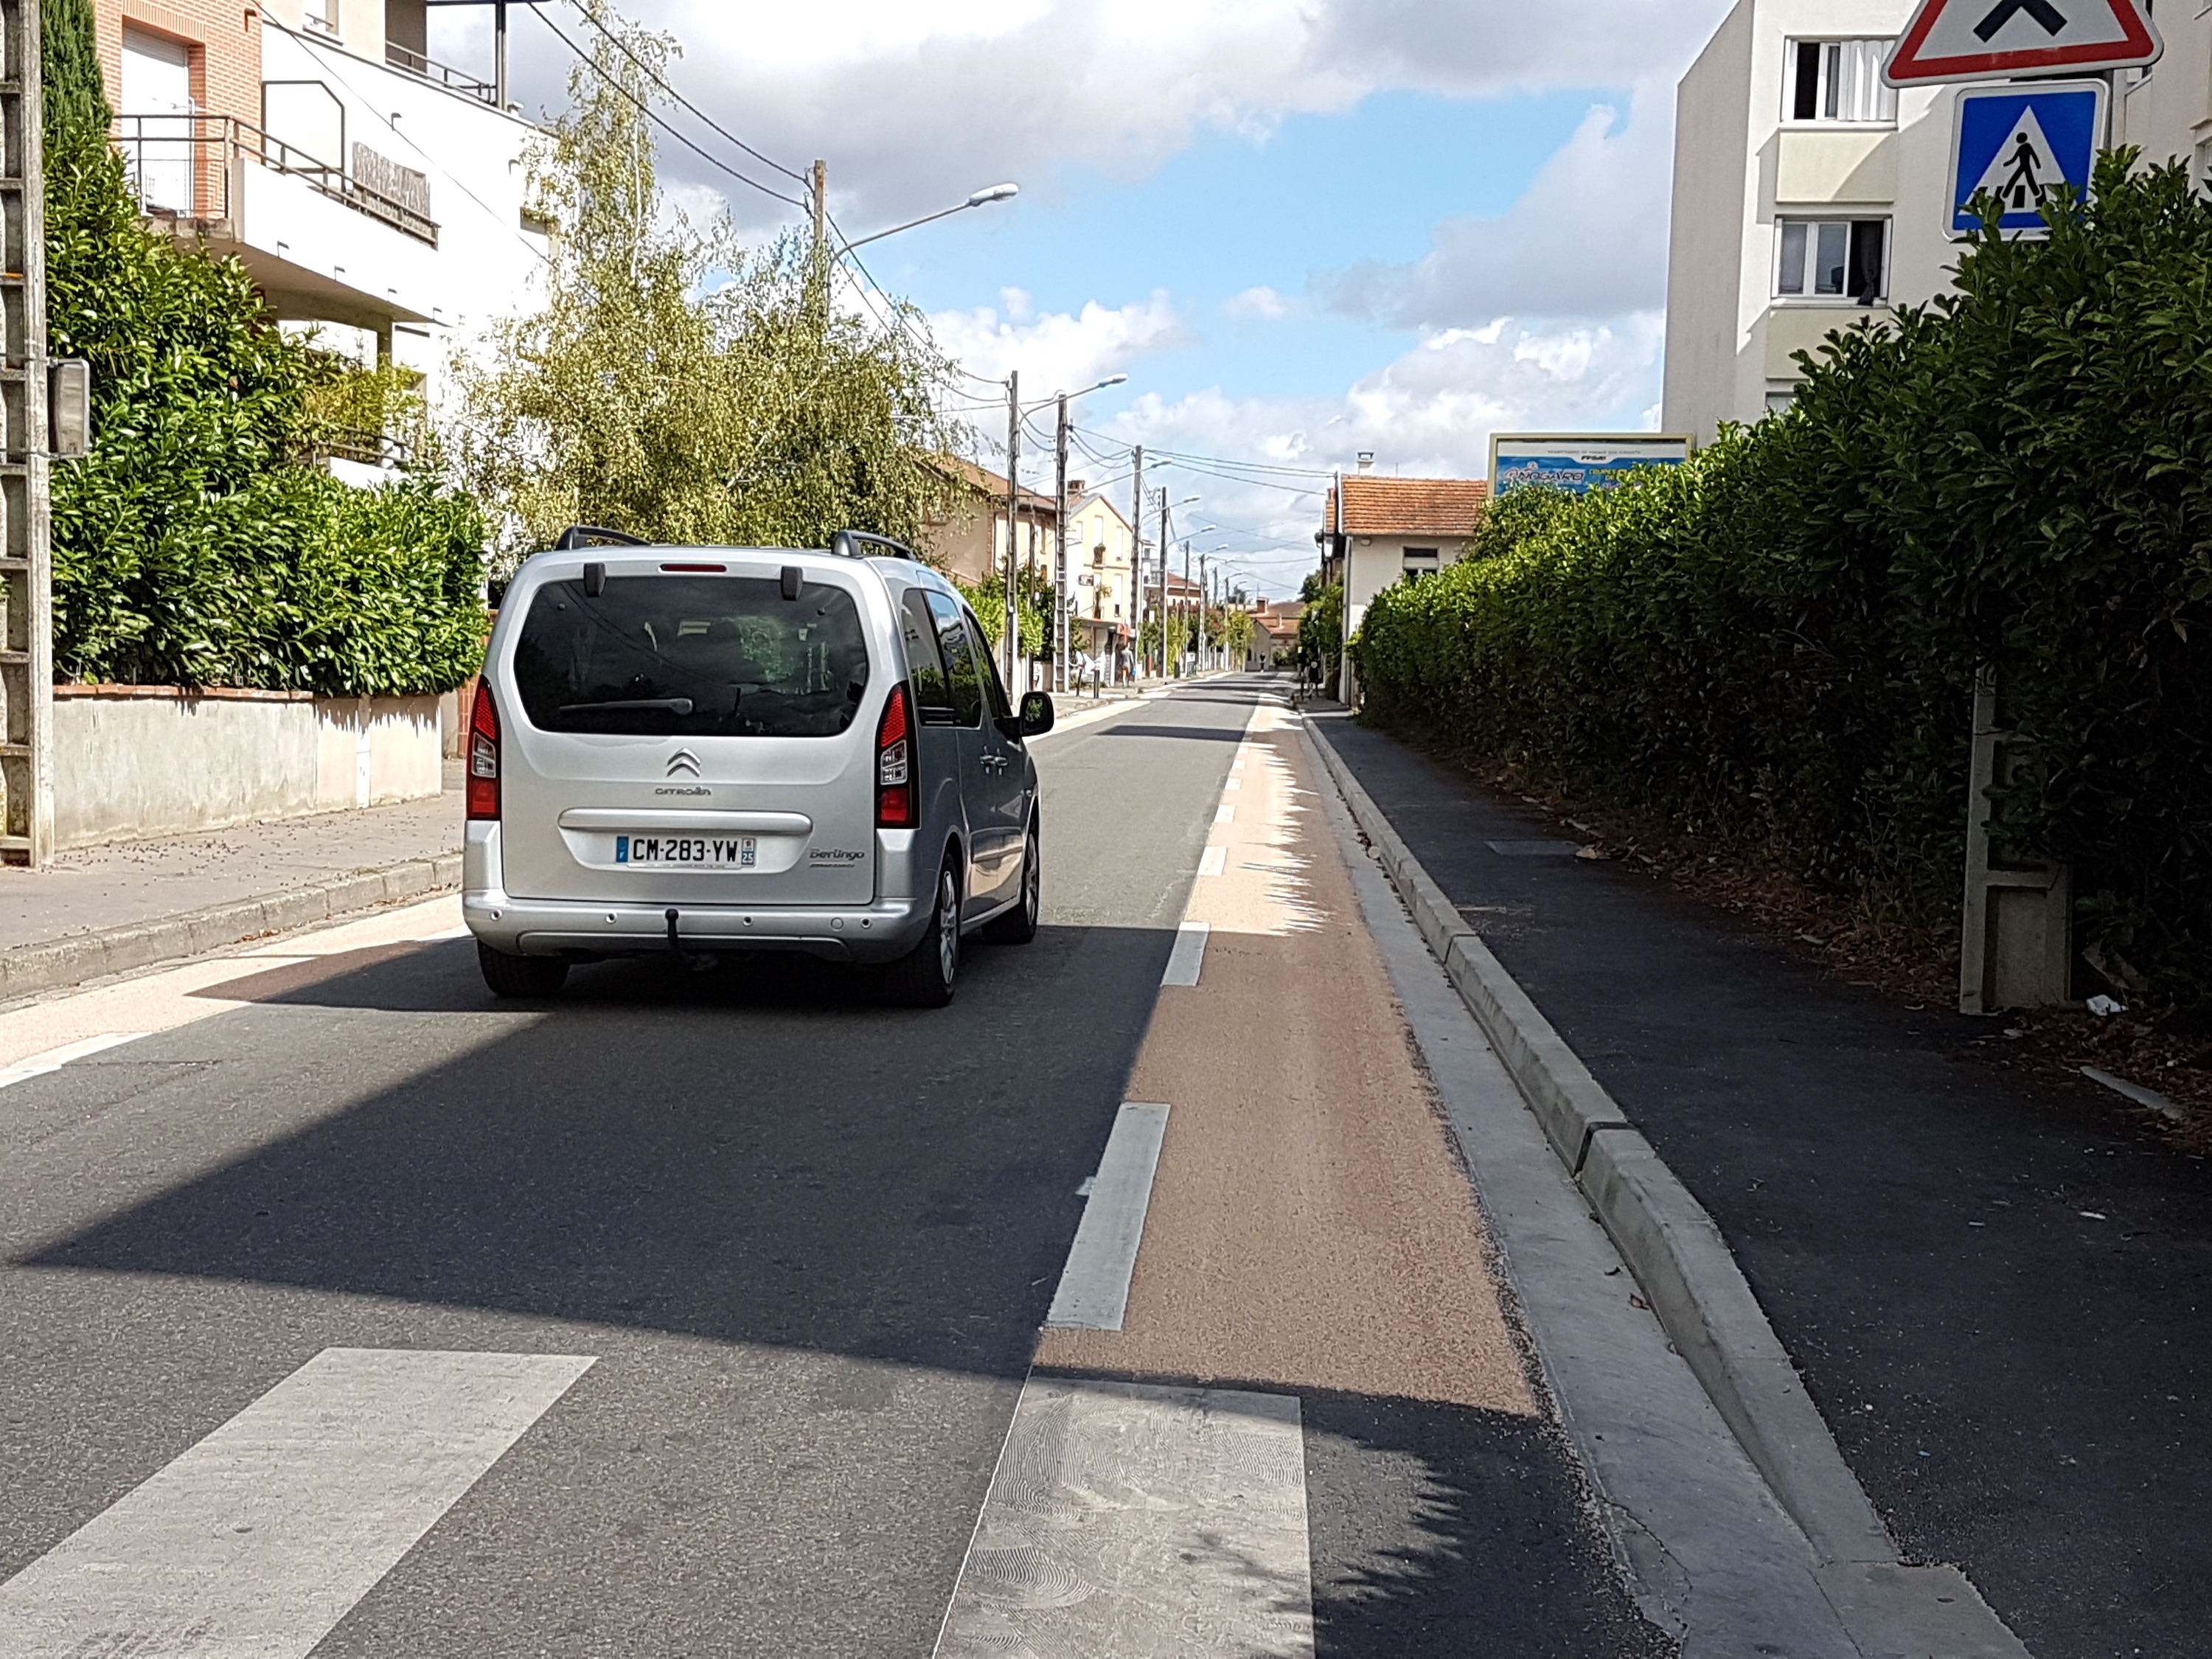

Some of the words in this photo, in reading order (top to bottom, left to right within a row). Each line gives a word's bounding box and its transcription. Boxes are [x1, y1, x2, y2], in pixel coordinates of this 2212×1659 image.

[1518, 470, 1585, 481] NOGARO
[633, 838, 738, 862] CM-283-YW
[742, 852, 754, 863] 25
